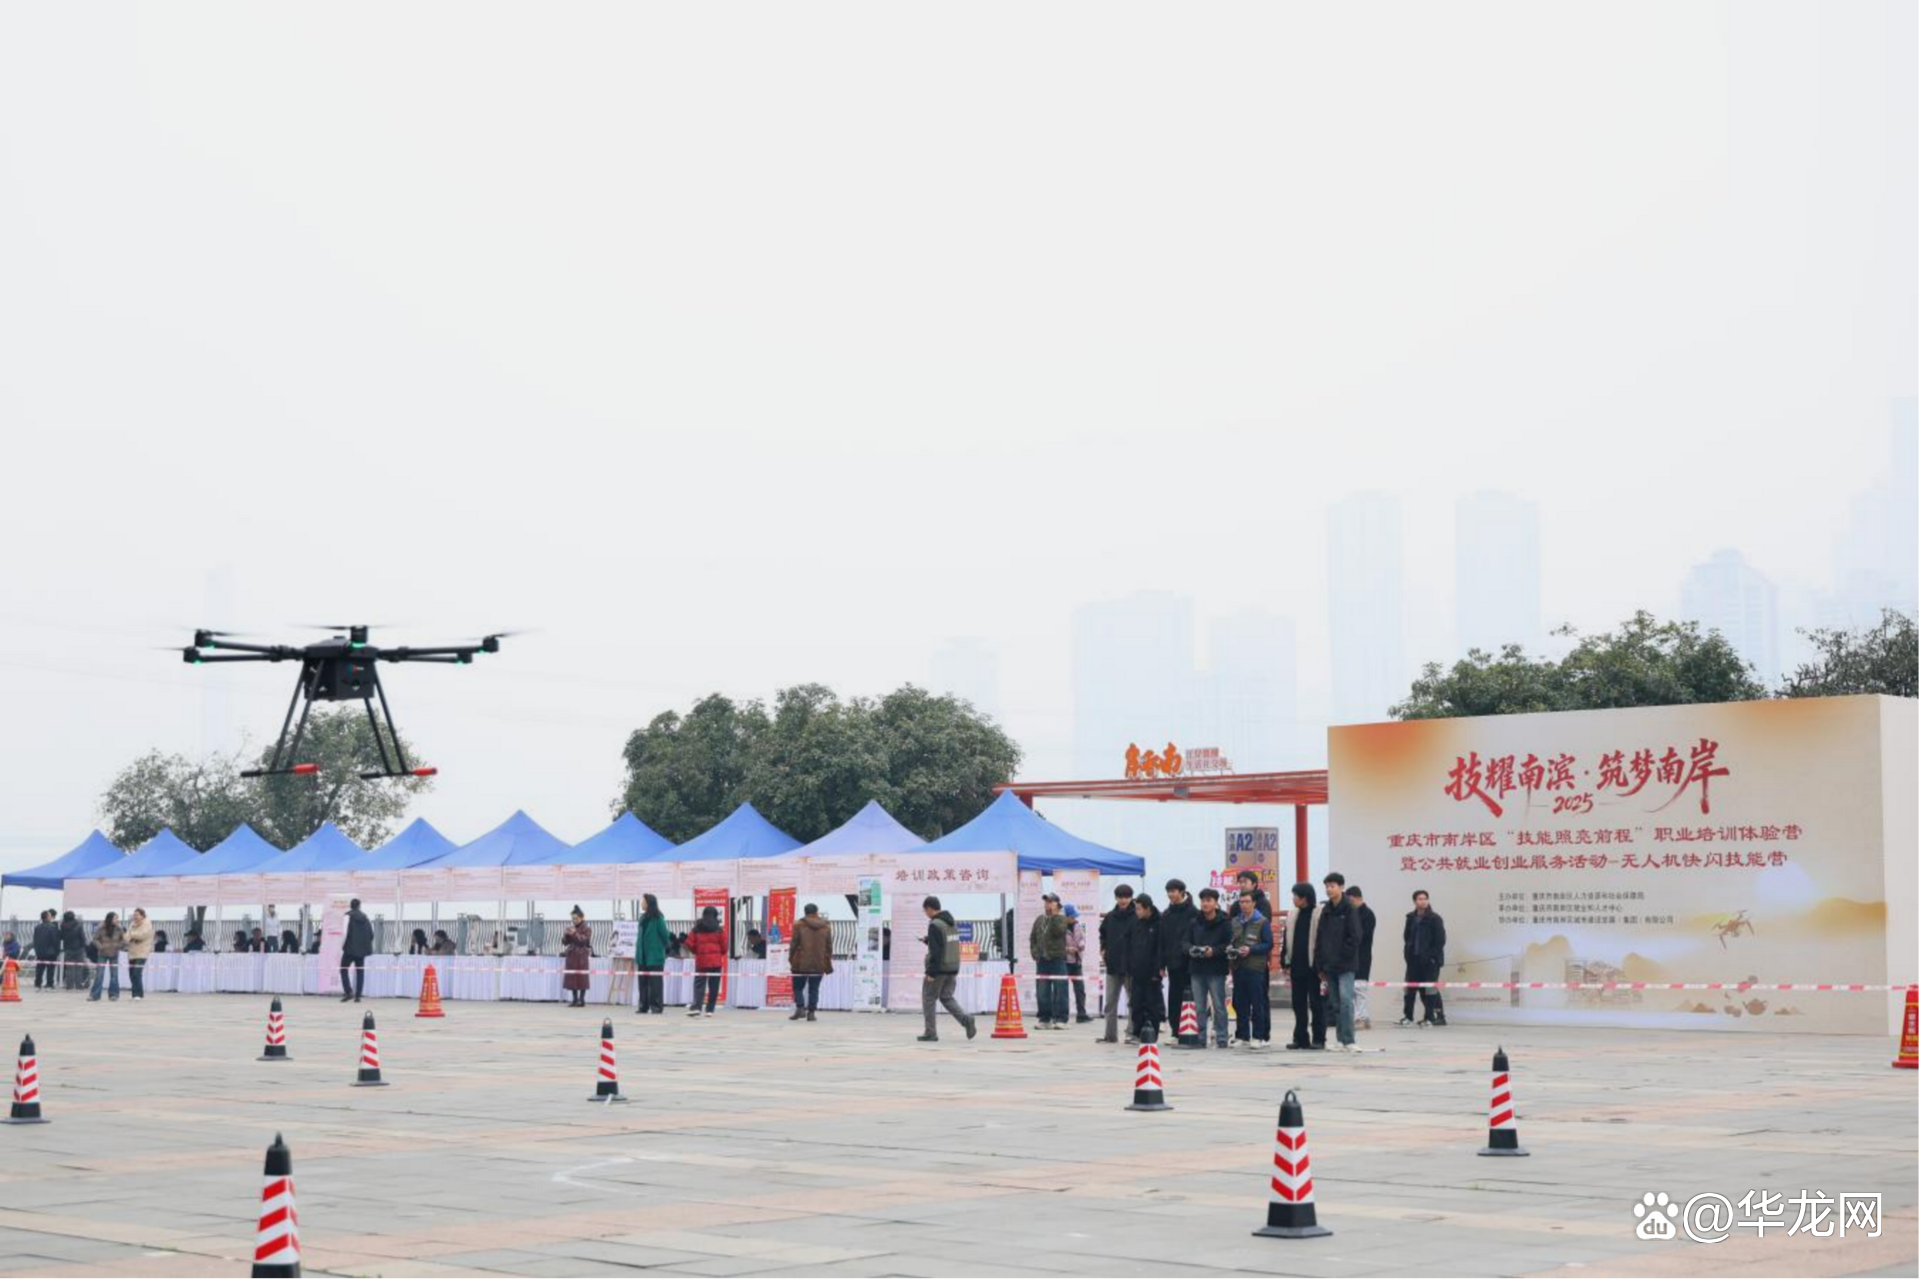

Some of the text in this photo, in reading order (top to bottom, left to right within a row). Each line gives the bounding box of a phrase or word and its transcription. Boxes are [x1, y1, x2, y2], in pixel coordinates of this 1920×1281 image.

[1444, 738, 1730, 818] 技耀南滨·筑梦南岸
[1553, 792, 1594, 815] 2025
[1236, 832, 1253, 851] A2
[1263, 832, 1277, 851] A2
[895, 868, 989, 882] 培训政策咨询
